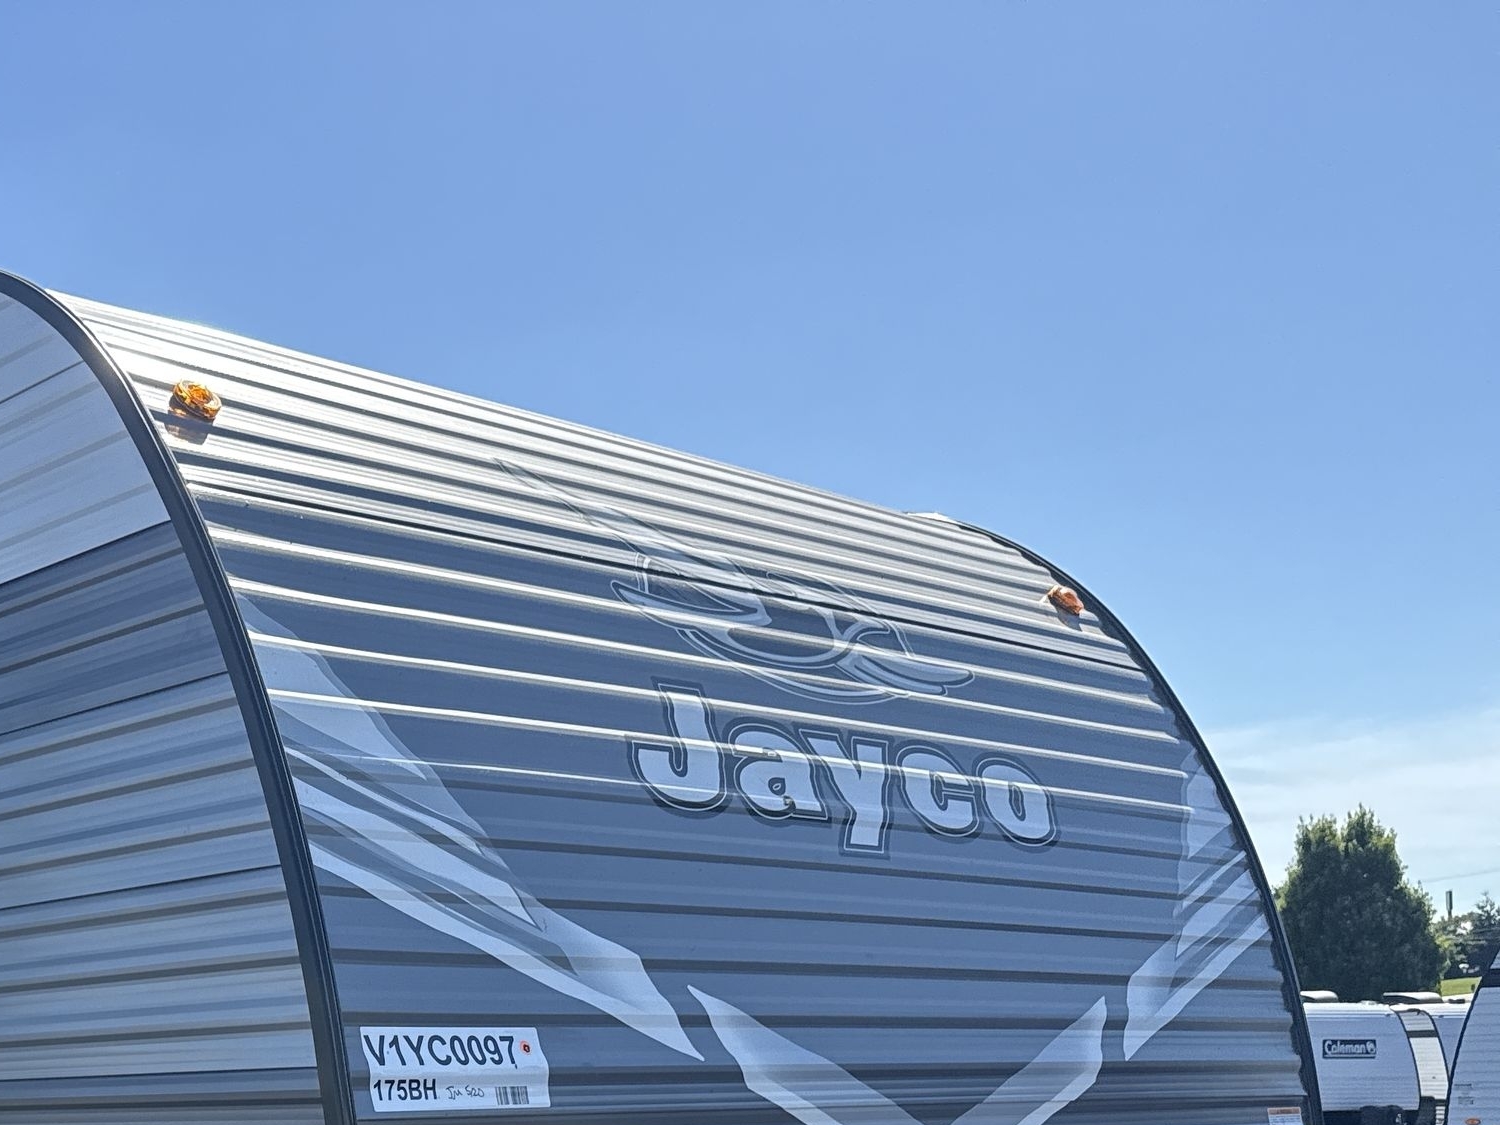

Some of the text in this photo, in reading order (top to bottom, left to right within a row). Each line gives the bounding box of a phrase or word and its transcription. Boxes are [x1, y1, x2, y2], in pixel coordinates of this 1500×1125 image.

[629, 678, 1060, 858] Jayco
[363, 1034, 516, 1066] V1YC0097
[1324, 1040, 1367, 1055] Coleman
[373, 1079, 437, 1101] 175BH
